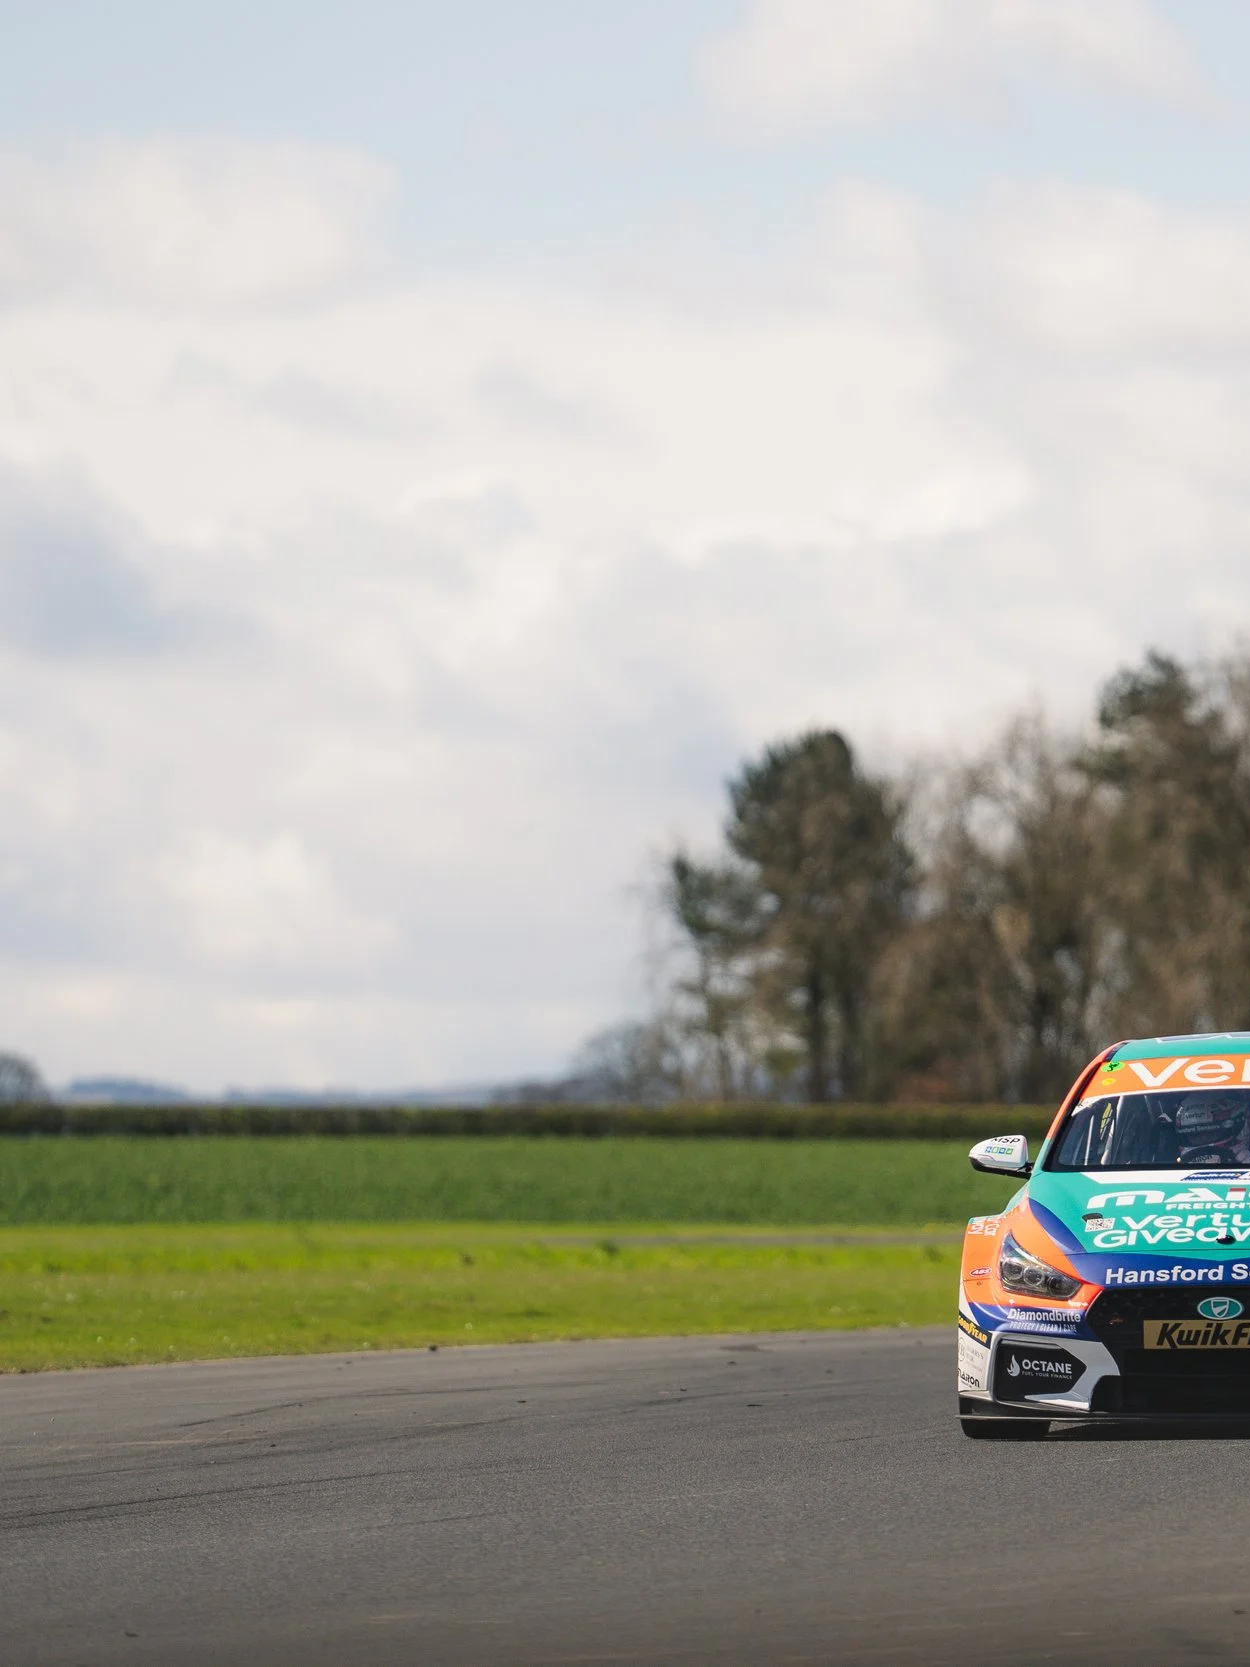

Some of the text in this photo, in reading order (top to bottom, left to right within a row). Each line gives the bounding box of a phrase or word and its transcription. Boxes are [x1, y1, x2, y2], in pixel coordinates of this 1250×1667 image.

[1105, 1264, 1225, 1285] Hansford
[1007, 1308, 1081, 1322] Diamondbrite
[1022, 1359, 1072, 1374] OCTANE
